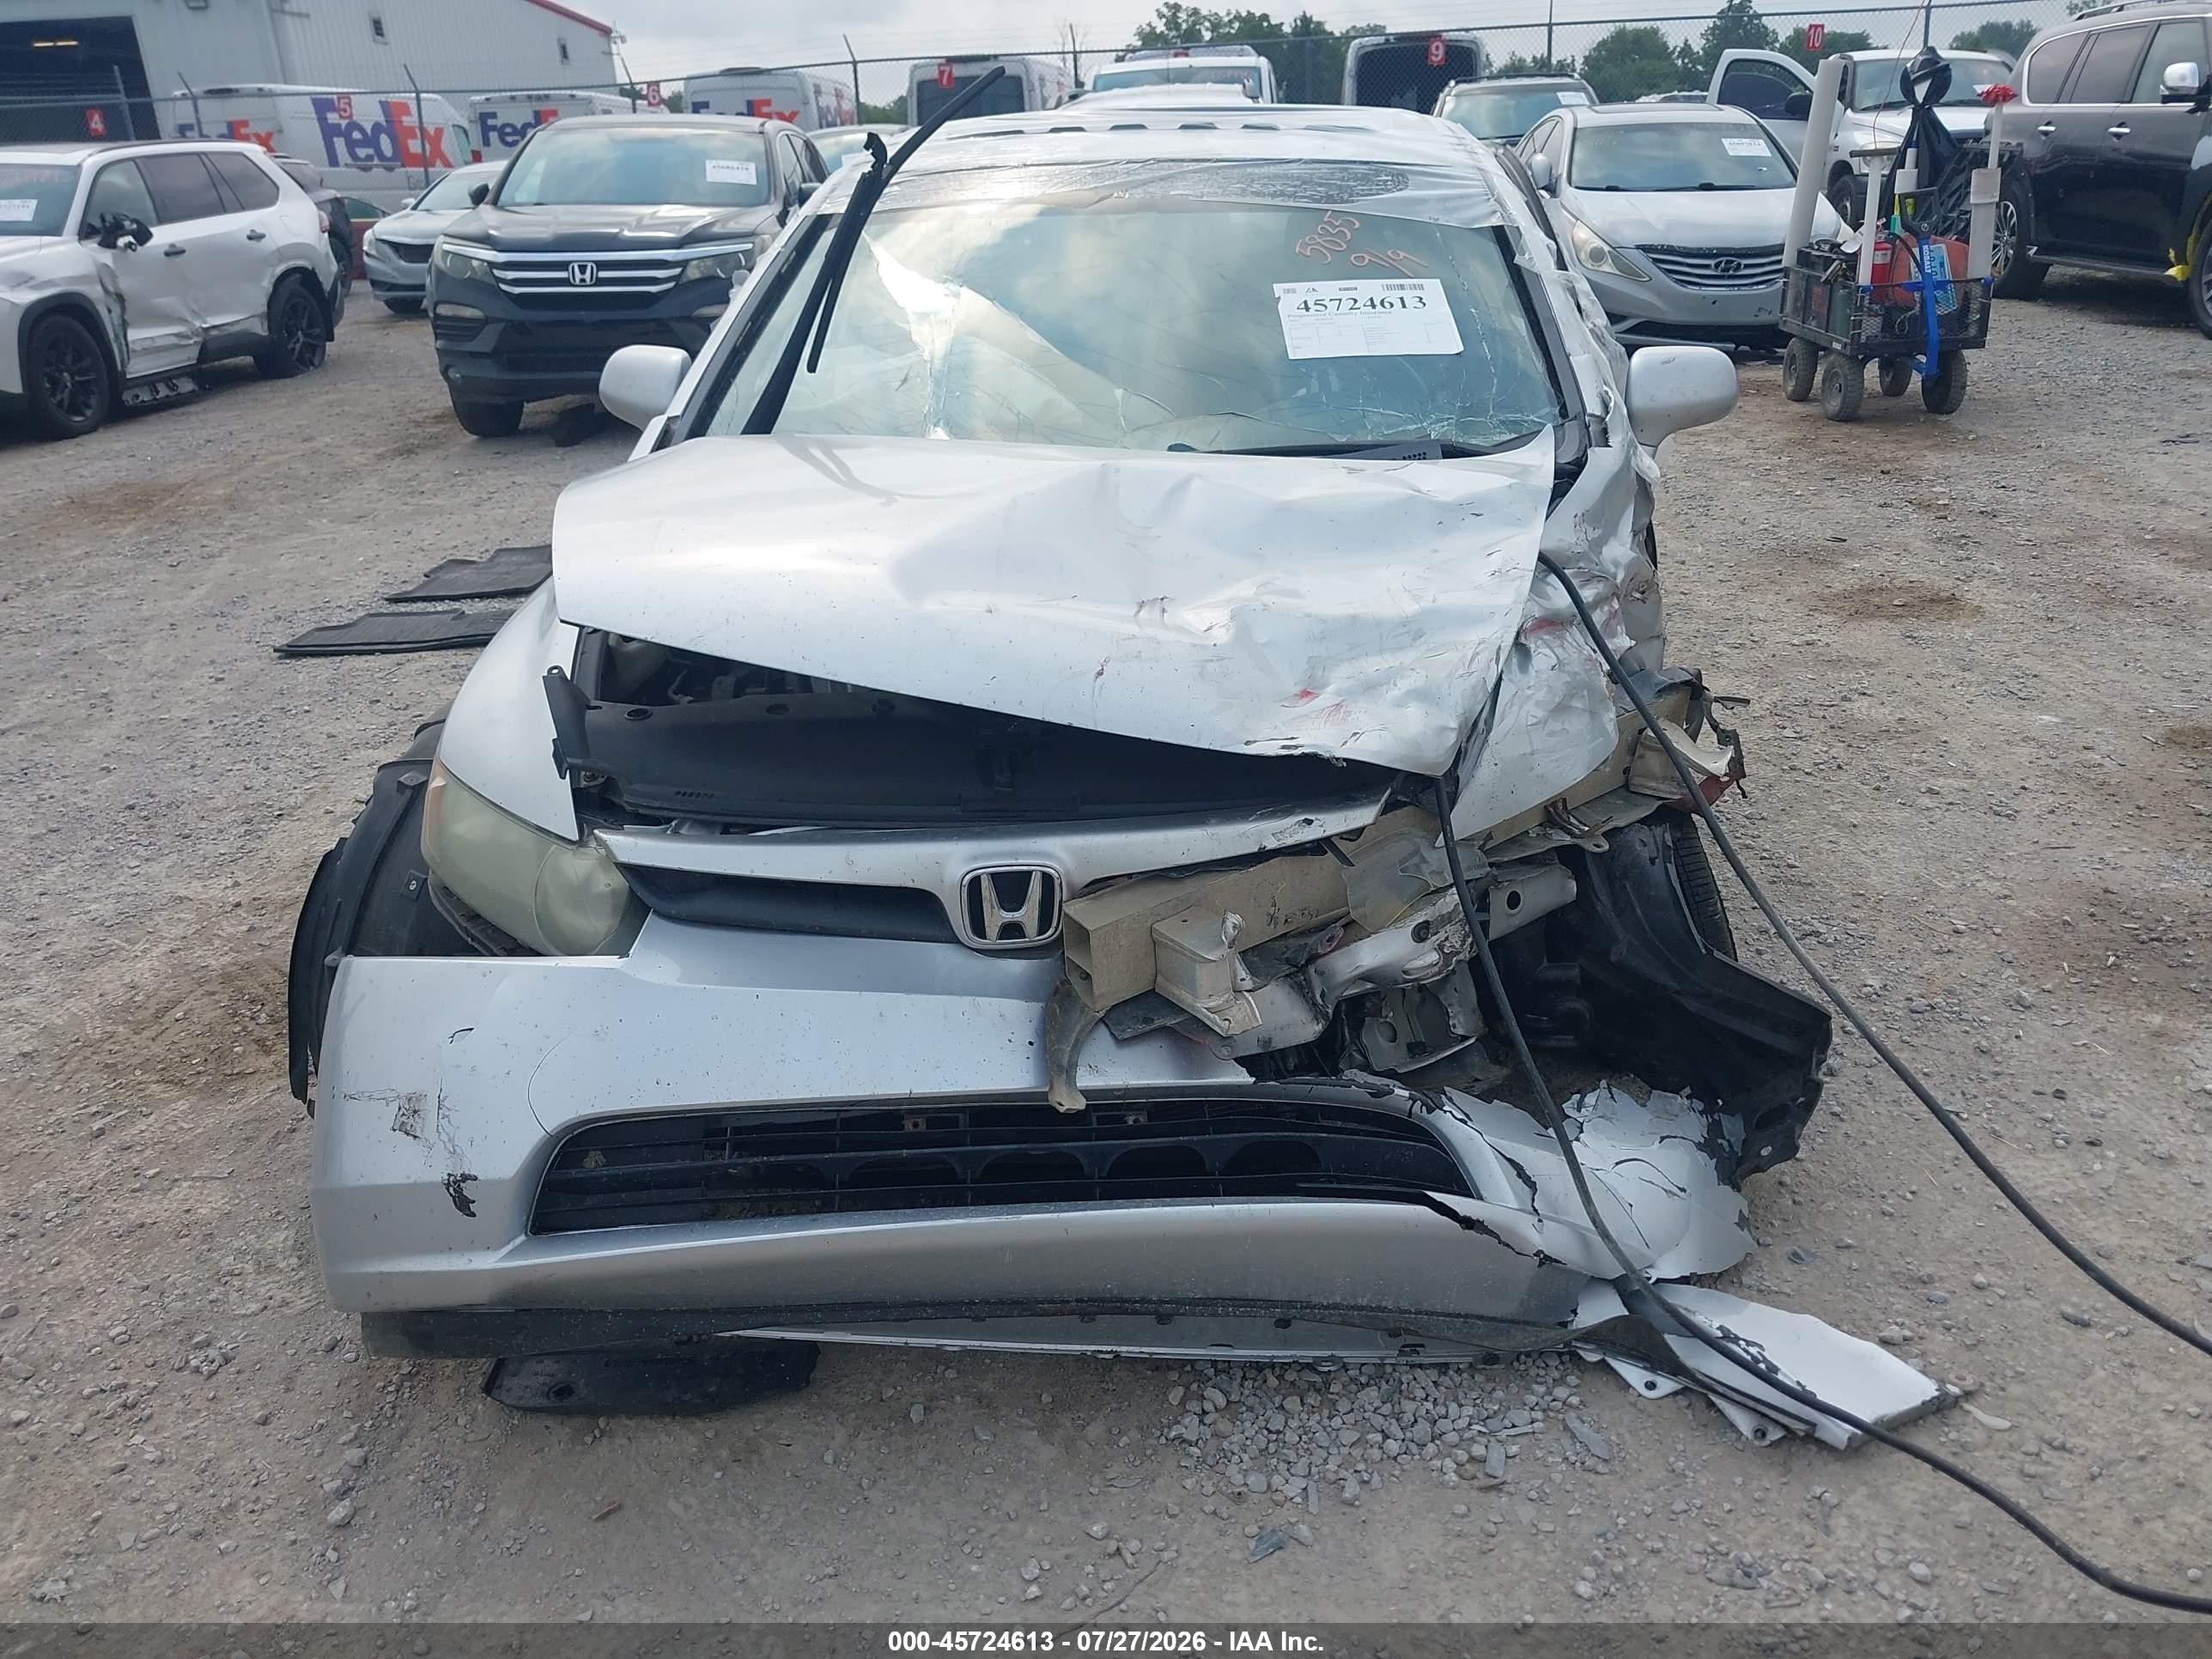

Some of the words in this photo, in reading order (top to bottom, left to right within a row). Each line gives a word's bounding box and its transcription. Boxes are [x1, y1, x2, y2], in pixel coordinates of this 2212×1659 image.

[1808, 27, 1821, 47] 10
[1431, 40, 1443, 62] 9
[940, 65, 951, 85] 7
[647, 86, 659, 104] 6
[339, 98, 351, 117] 5
[91, 112, 103, 133] 4
[478, 109, 559, 148] Fed
[310, 96, 454, 171] FedEx
[1297, 295, 1427, 313] 45724613
